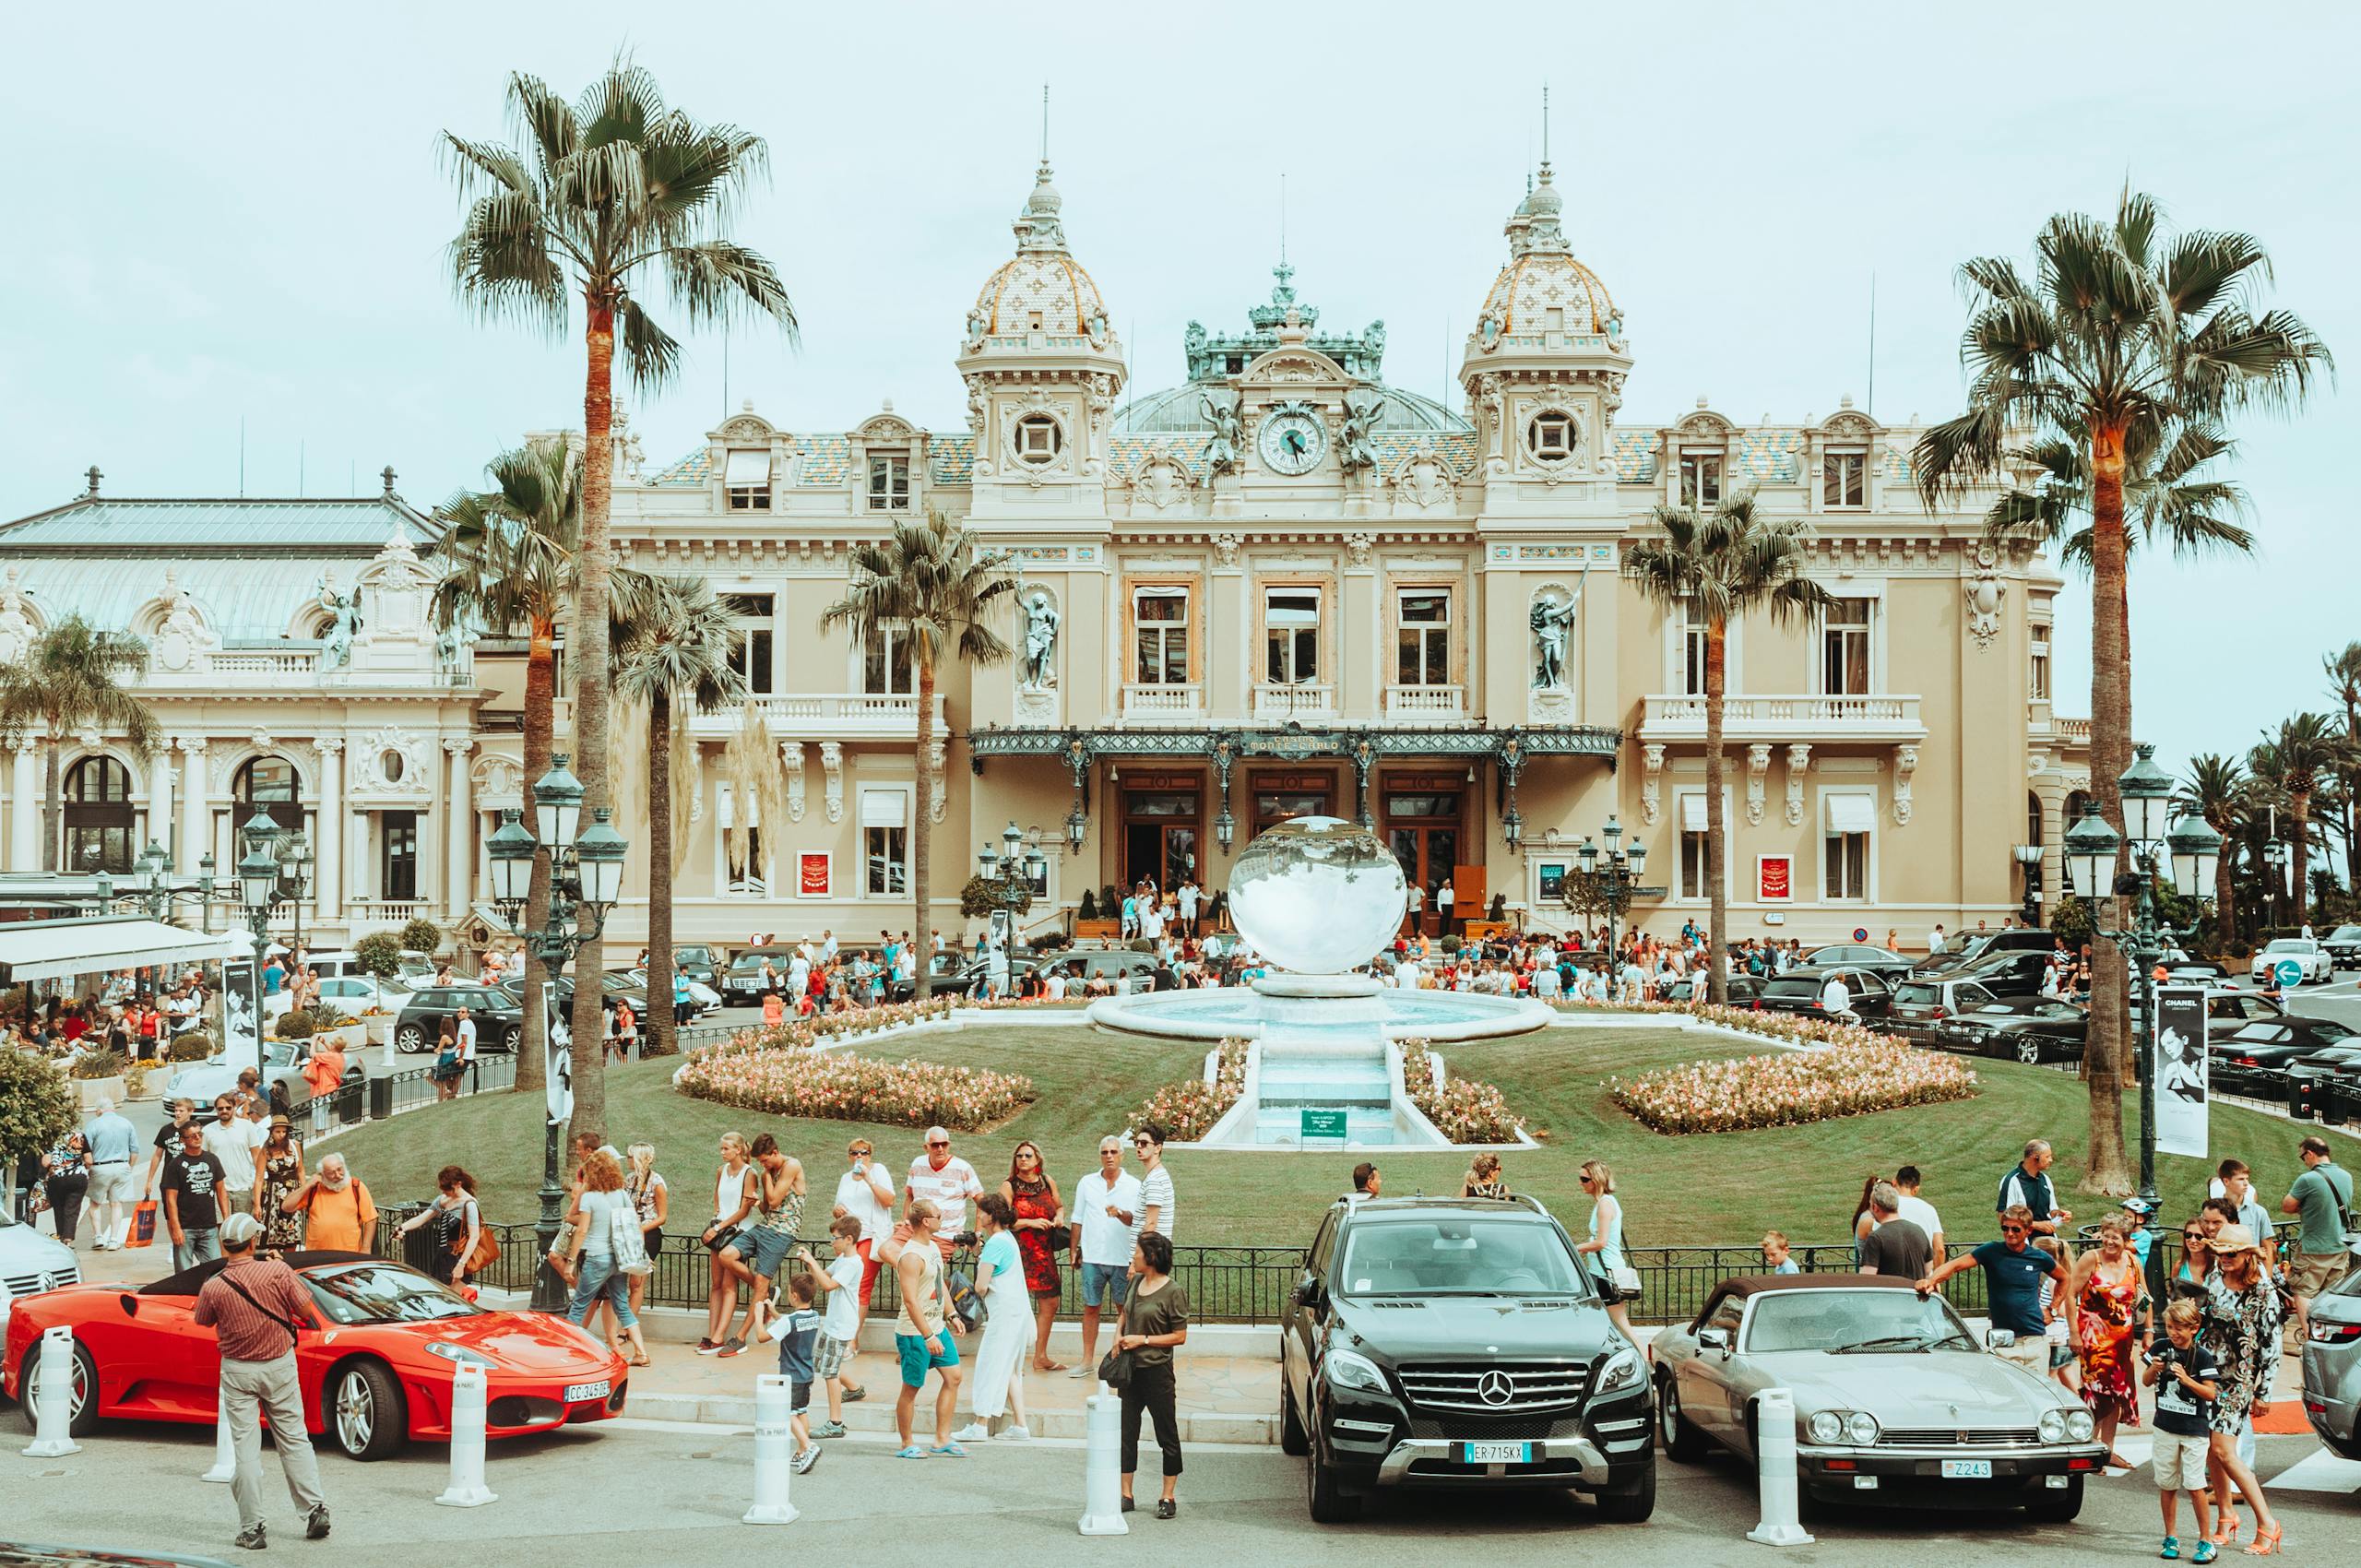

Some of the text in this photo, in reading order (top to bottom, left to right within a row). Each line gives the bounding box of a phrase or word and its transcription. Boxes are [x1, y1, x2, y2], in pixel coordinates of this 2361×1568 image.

[1250, 742, 1339, 750] MONTE-CARLO
[2165, 999, 2198, 1007] CHANEL
[1955, 1463, 1989, 1476] Z243
